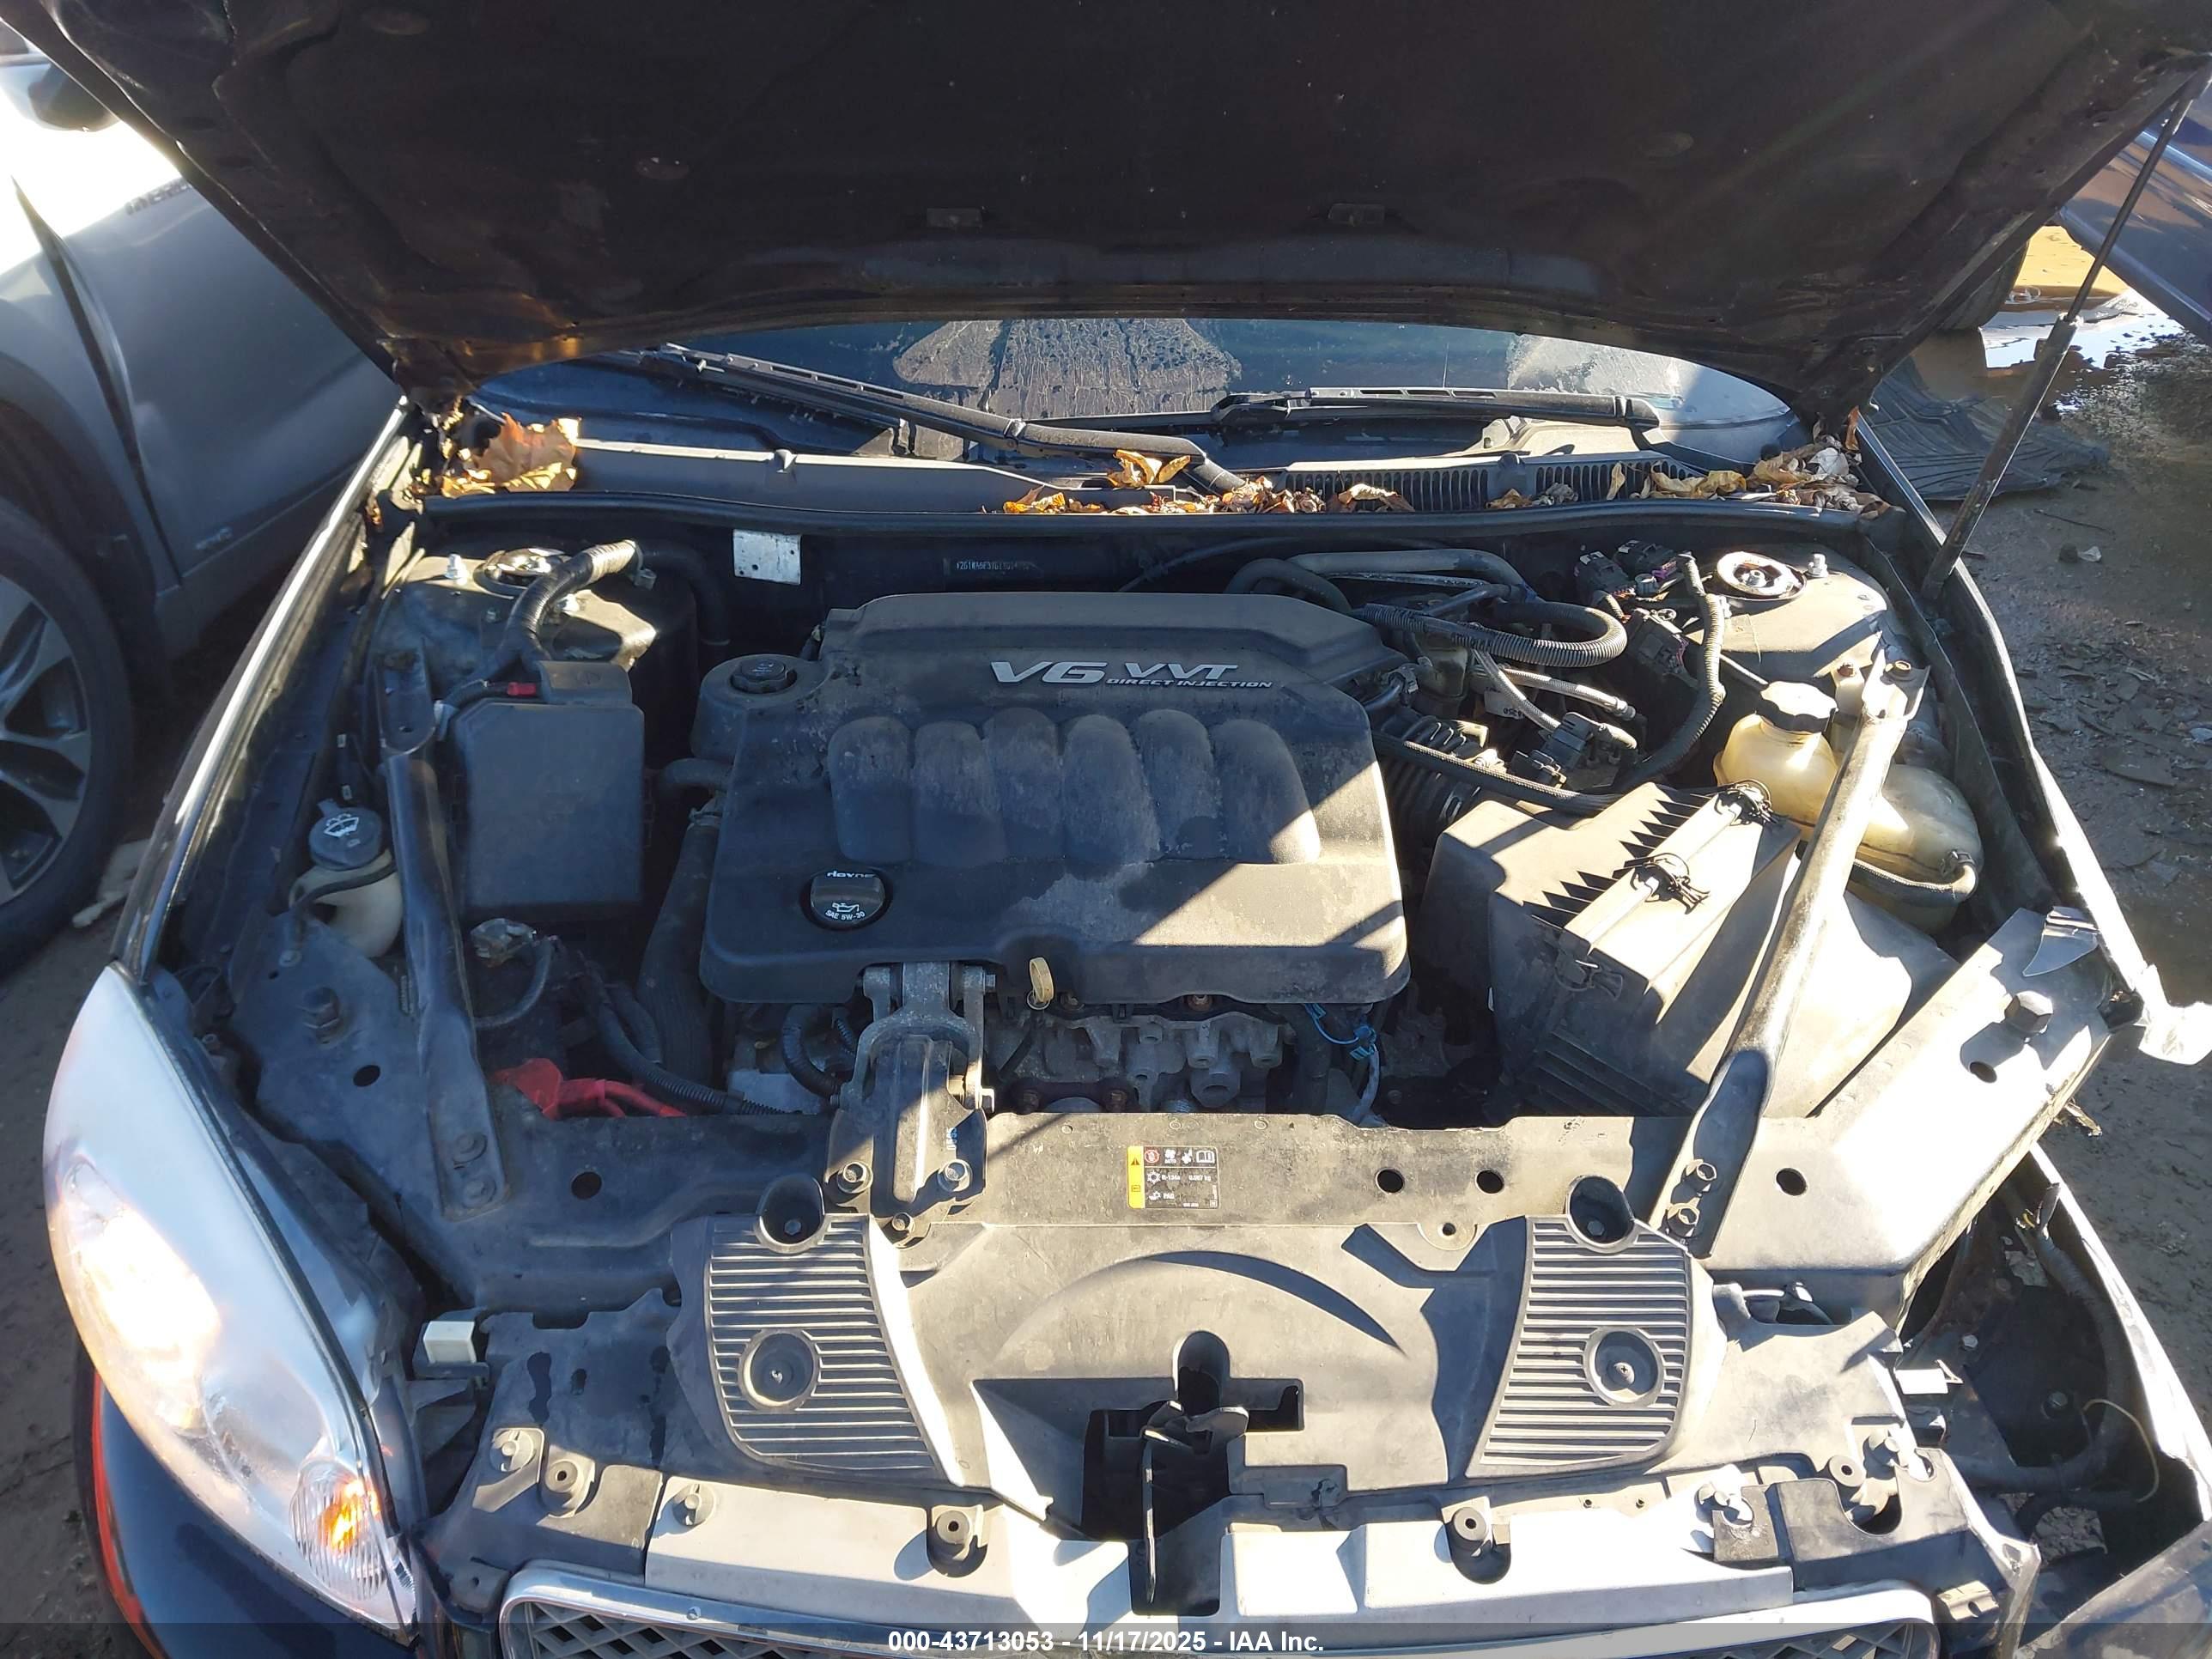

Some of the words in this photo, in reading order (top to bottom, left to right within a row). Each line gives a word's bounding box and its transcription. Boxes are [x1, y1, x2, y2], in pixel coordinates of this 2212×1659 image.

[990, 661, 1109, 684] V6
[1125, 662, 1238, 680] VVT
[825, 909, 840, 920] SAE
[841, 910, 866, 921] 5W-30
